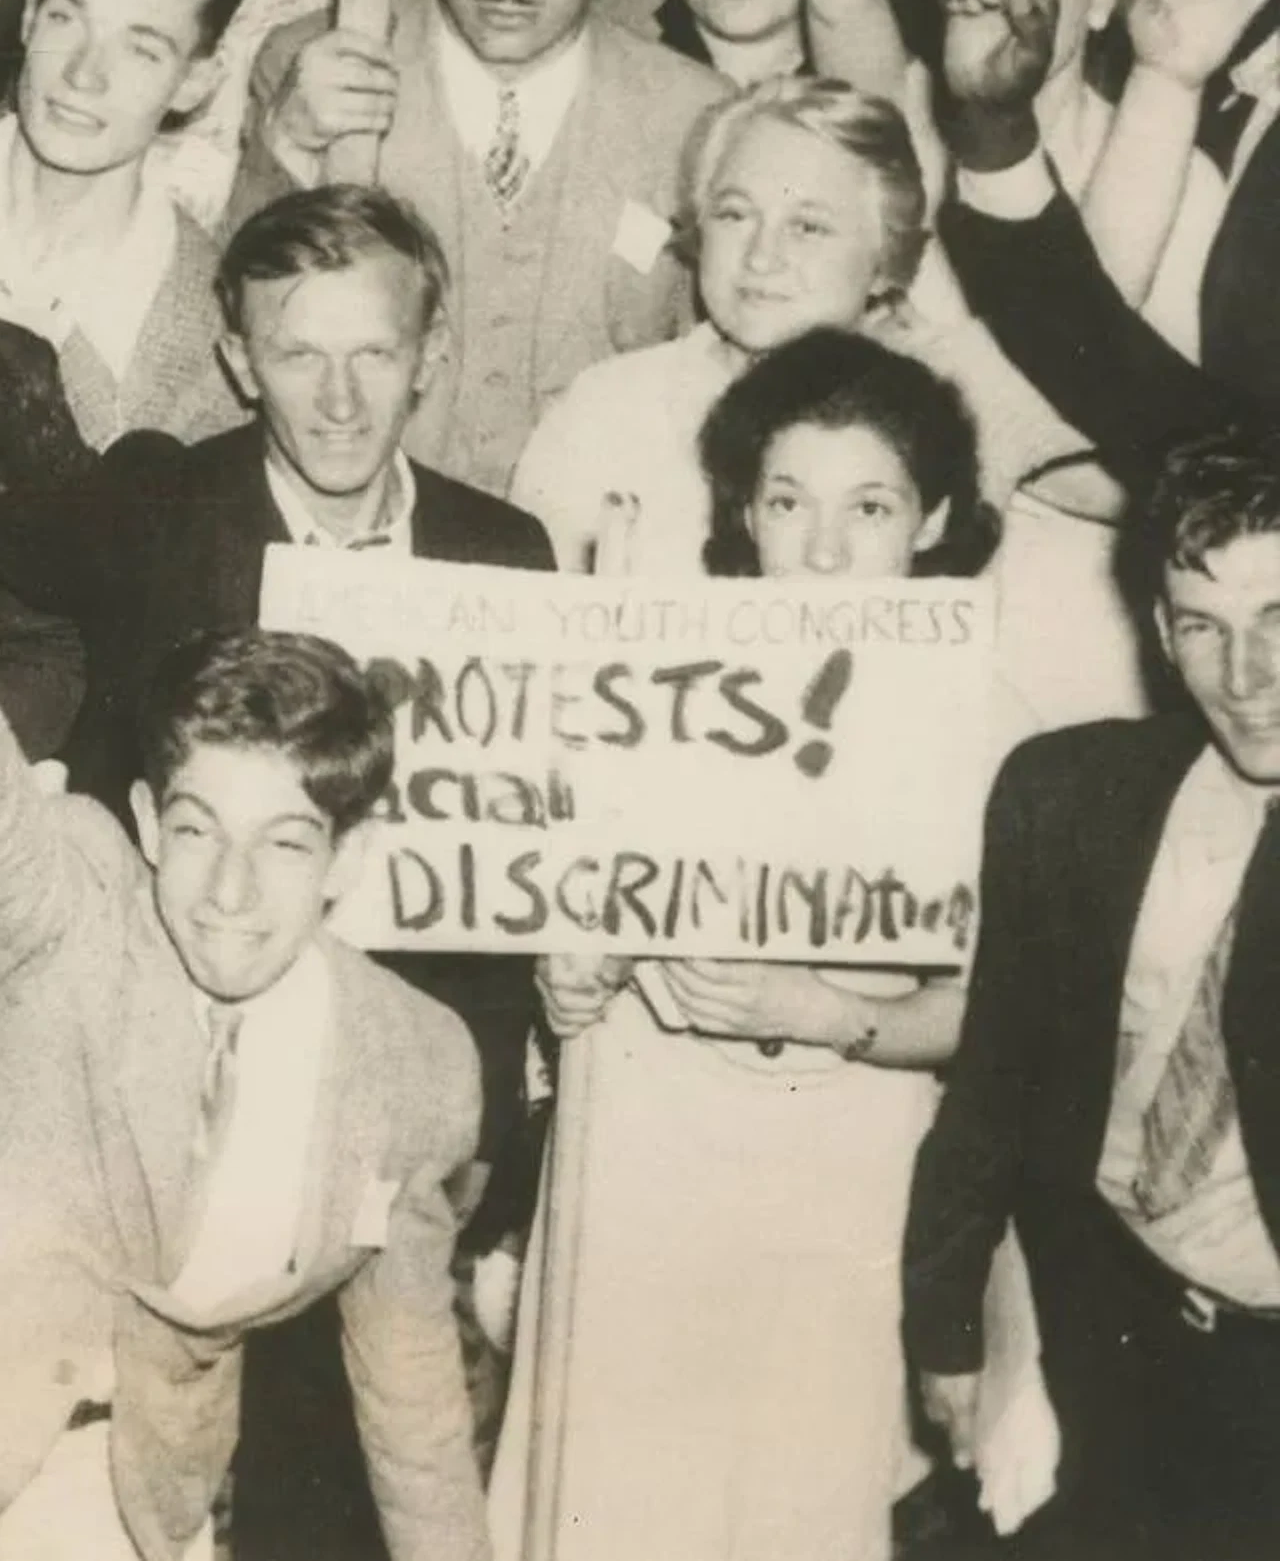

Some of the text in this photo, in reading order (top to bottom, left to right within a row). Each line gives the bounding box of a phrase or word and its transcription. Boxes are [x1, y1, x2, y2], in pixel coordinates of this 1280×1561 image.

[547, 595, 707, 644] YOUTH
[724, 597, 974, 648] CONGRESS
[368, 767, 576, 832] acial
